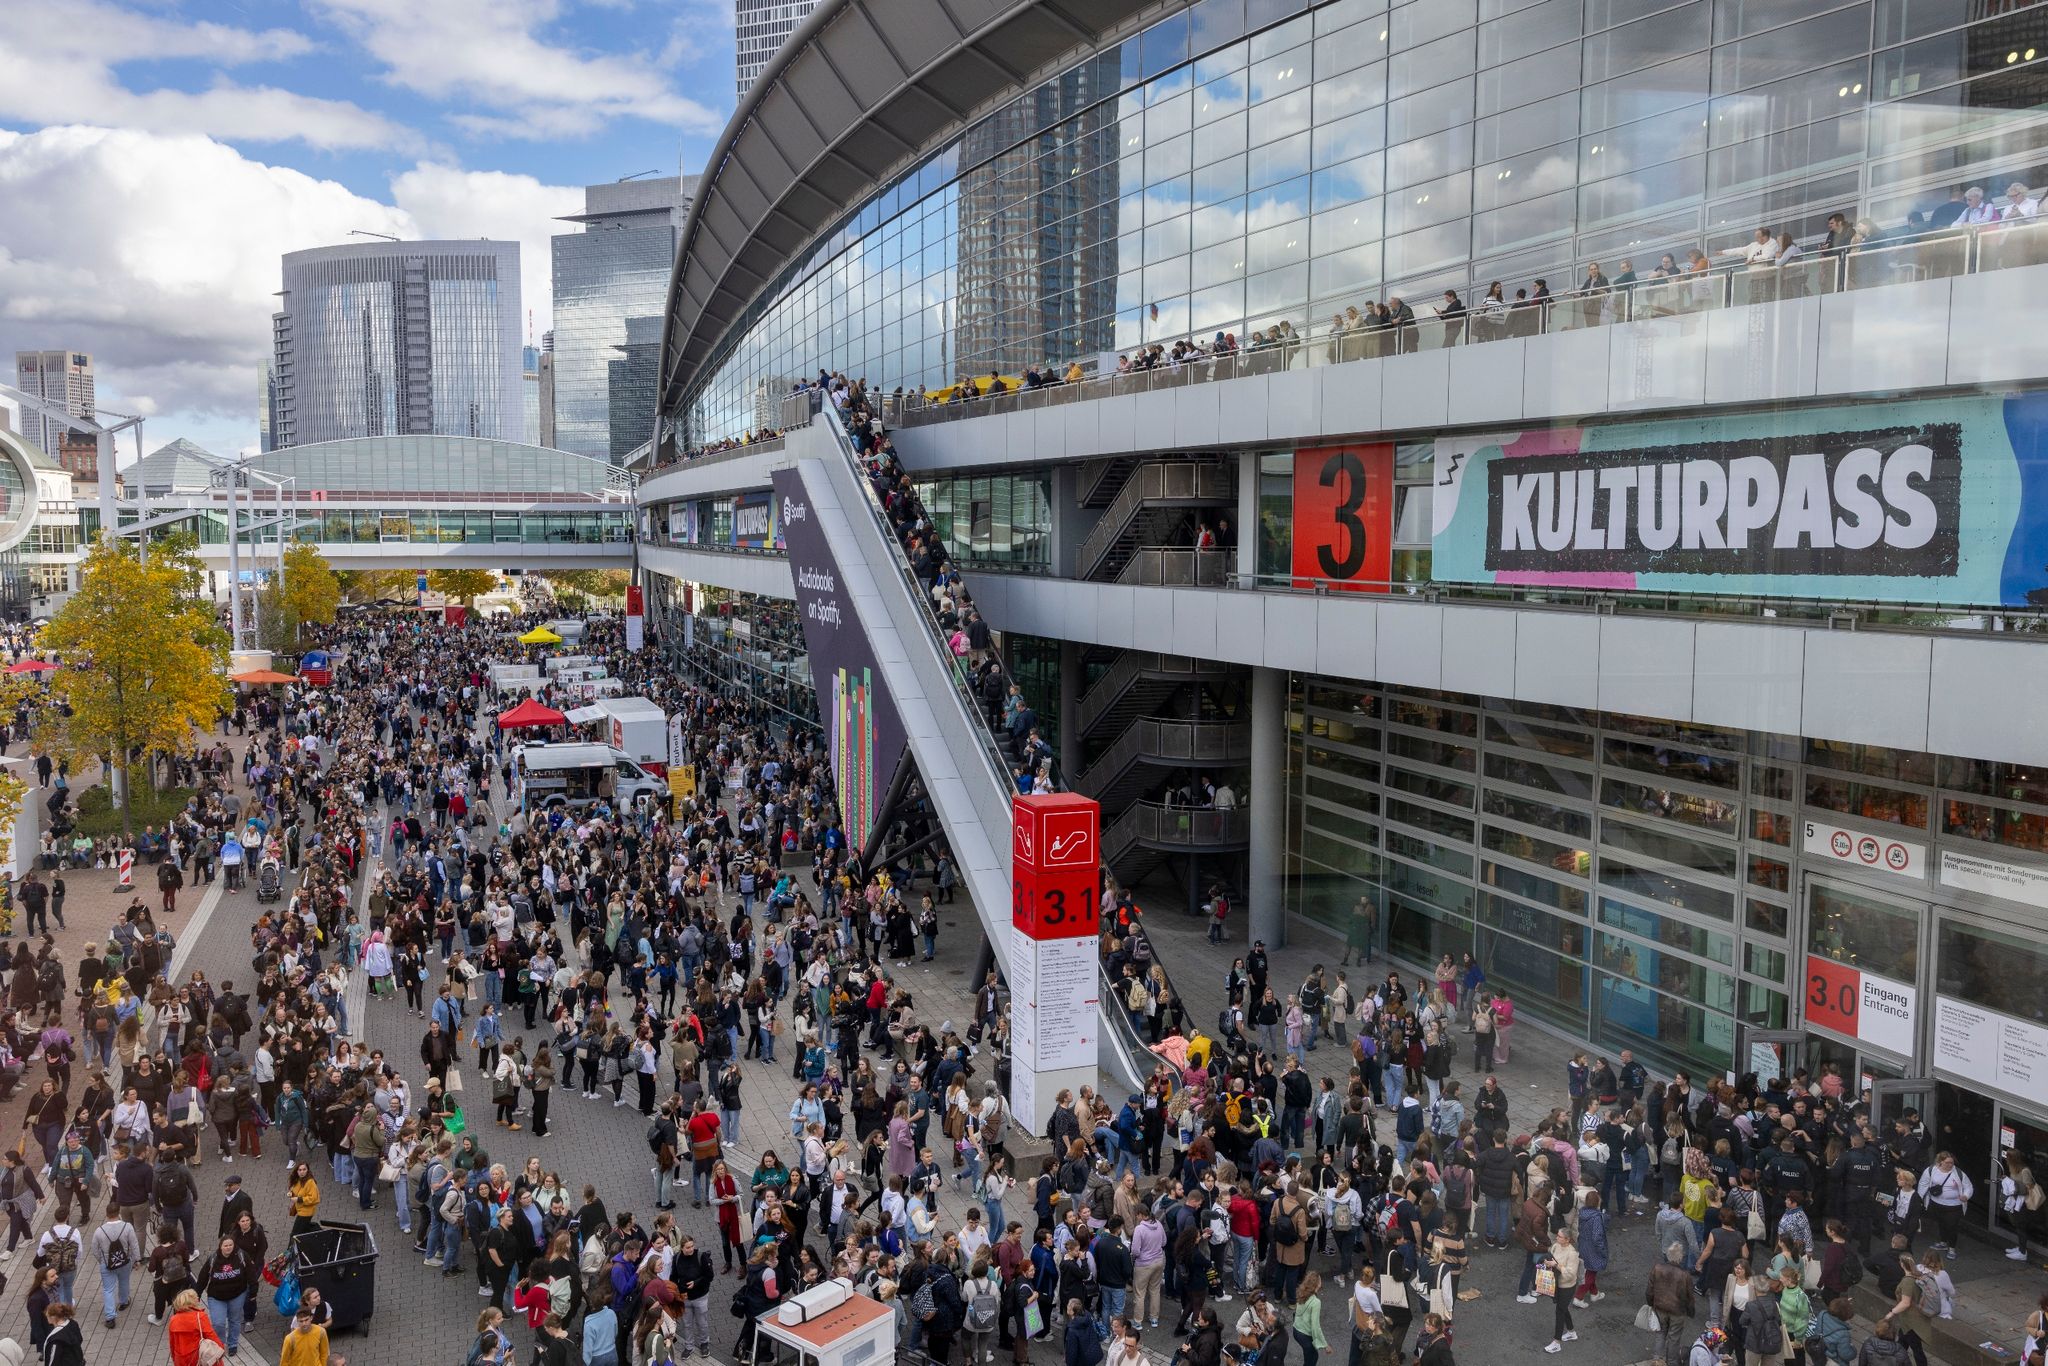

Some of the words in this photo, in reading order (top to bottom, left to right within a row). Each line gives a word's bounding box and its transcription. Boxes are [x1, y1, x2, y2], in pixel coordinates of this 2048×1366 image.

[791, 503, 807, 521] Spotify
[1500, 445, 1937, 552] KULTURPASS
[1317, 453, 1366, 579] 3
[799, 567, 834, 592] Audiobooks
[808, 602, 817, 619] on
[818, 598, 842, 630] Spotify.
[1806, 824, 1814, 838] 5
[1944, 861, 1959, 871] With
[1960, 866, 1982, 876] special
[1983, 871, 2010, 882] approval
[1994, 865, 2006, 873] mit
[1015, 881, 1034, 923] 3.1
[1044, 887, 1093, 925] 3.1
[1810, 975, 1856, 1017] 3.0
[1864, 981, 1908, 1008] Eingang
[1864, 995, 1909, 1020] Entrance
